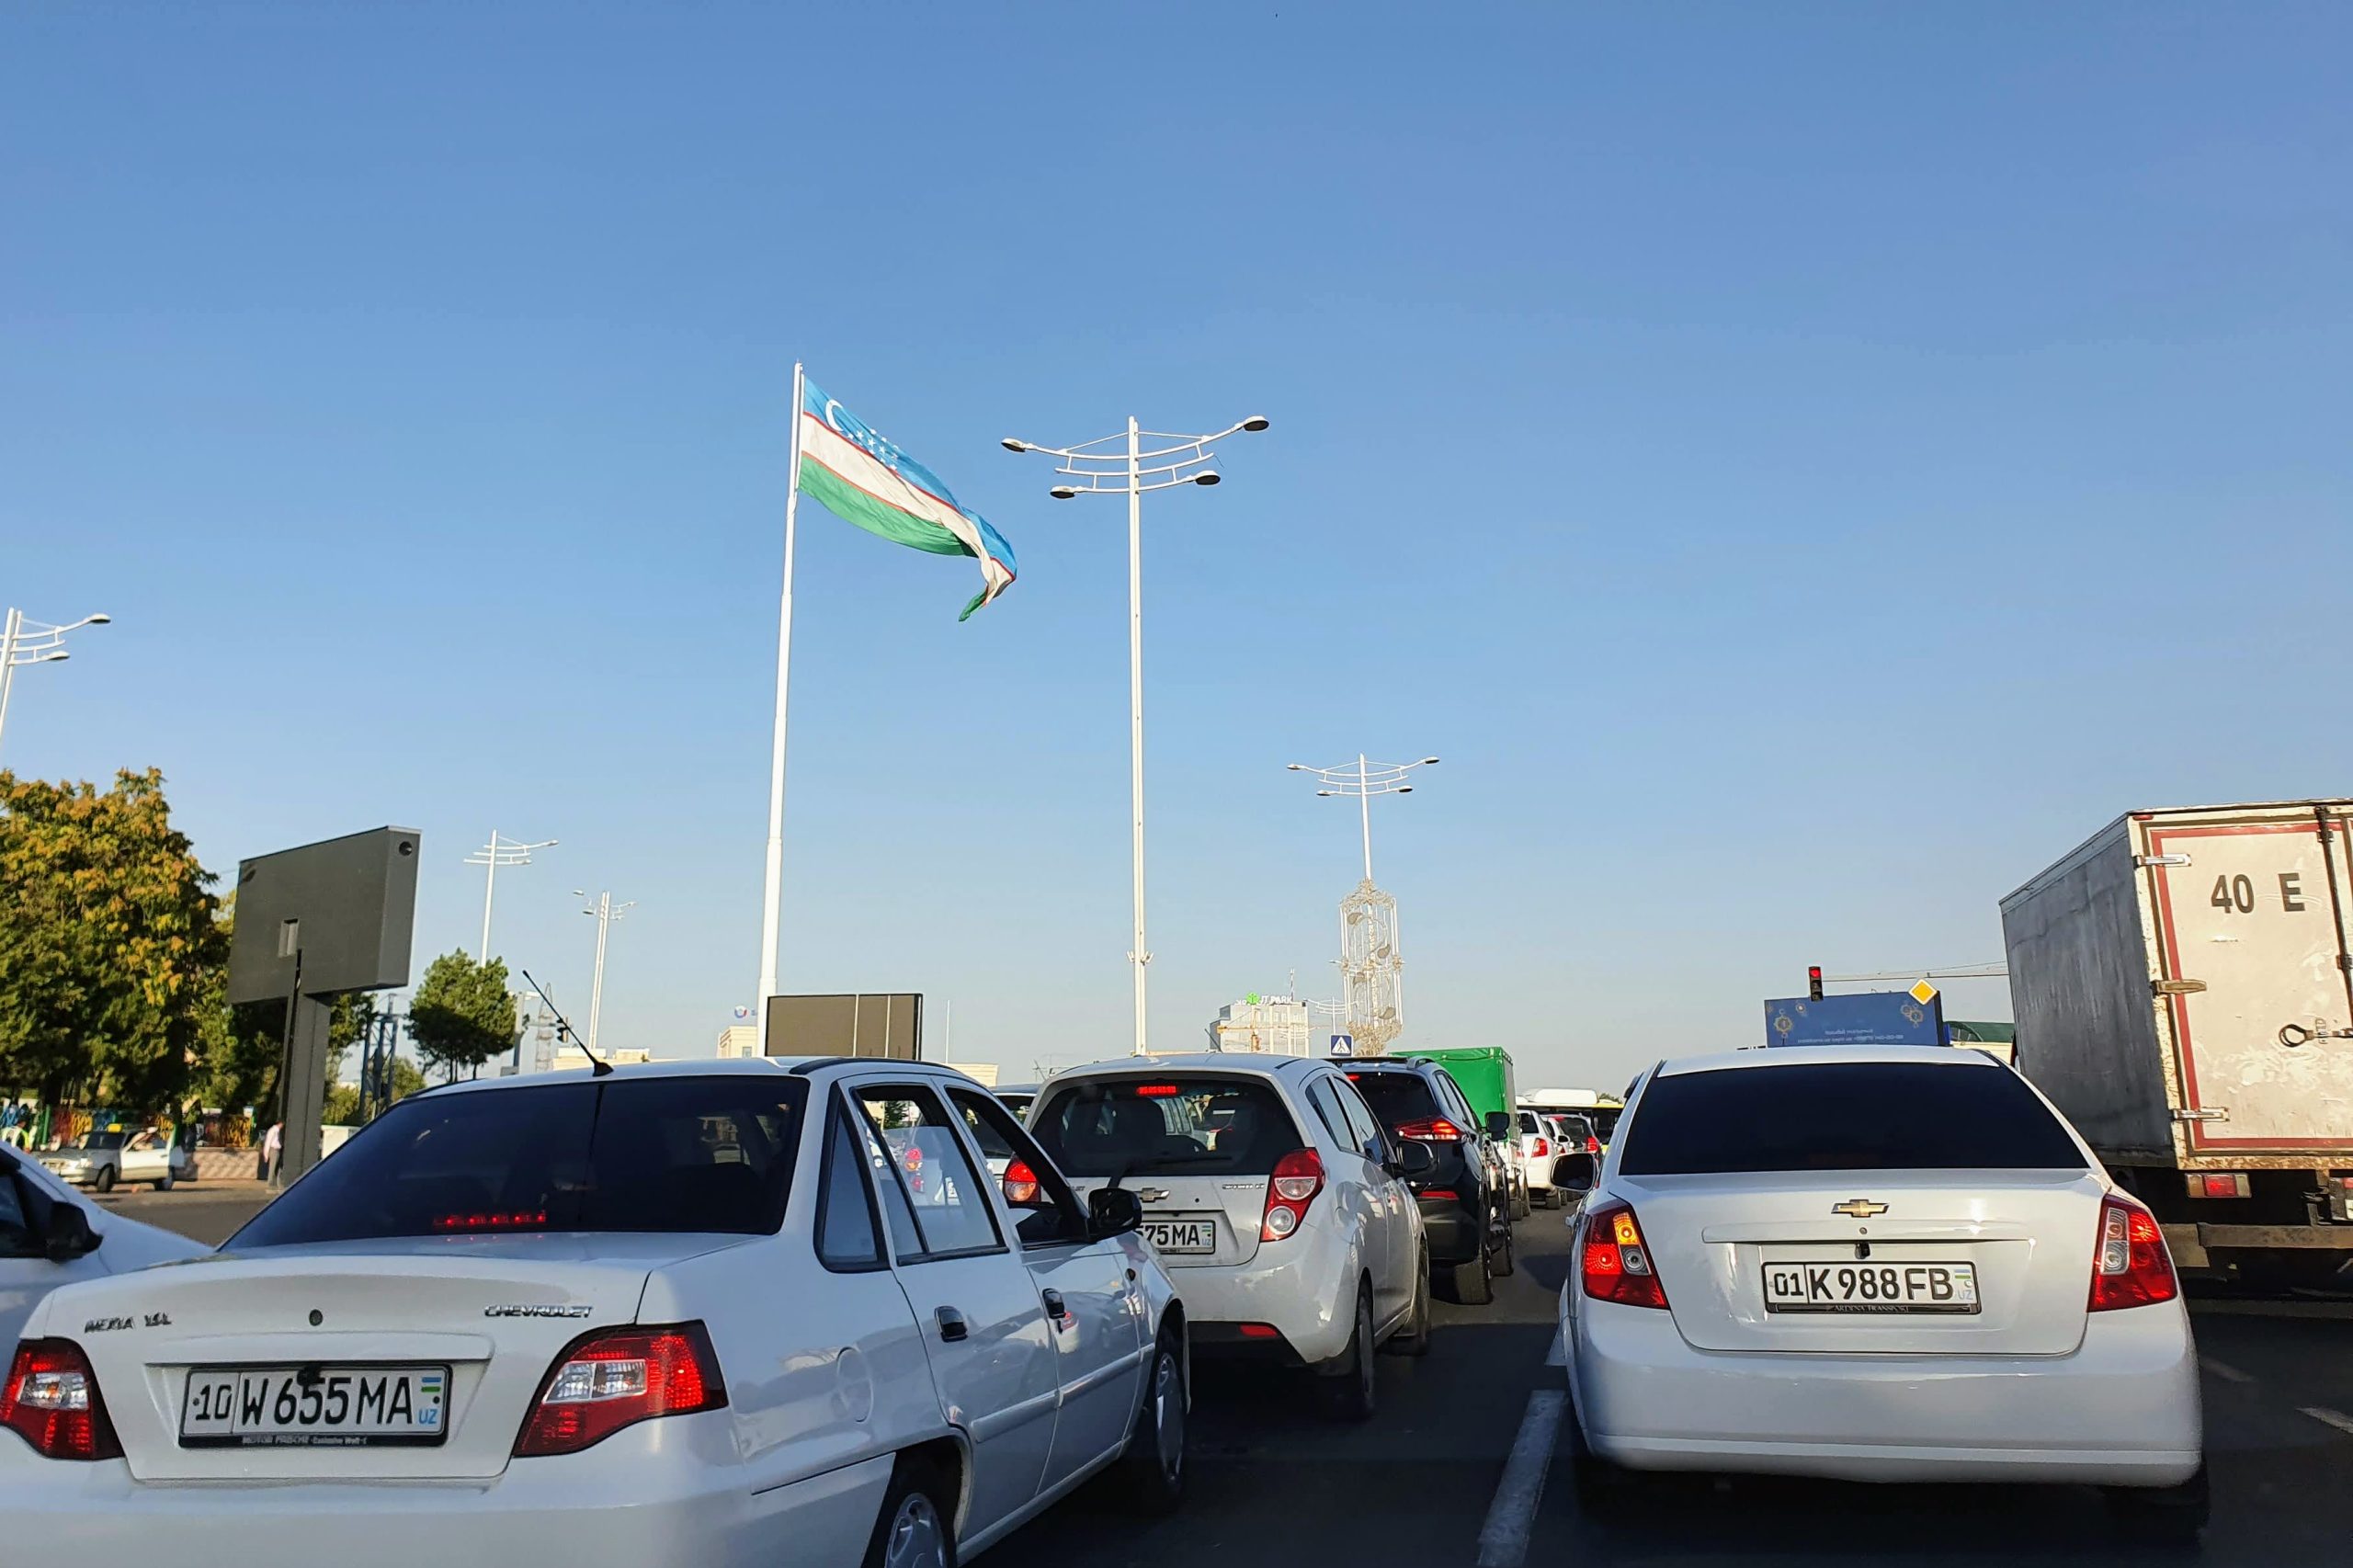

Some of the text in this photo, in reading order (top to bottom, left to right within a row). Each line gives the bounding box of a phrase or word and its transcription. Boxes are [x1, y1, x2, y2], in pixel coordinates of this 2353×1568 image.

[2211, 872, 2306, 914] 40 E
[1270, 995, 1292, 1005] PARK
[1773, 1272, 1804, 1297] 01
[1957, 1289, 1973, 1301] UZ
[484, 1305, 593, 1318] CHEVROLET
[194, 1383, 233, 1421] 10
[418, 1408, 438, 1424] UZ
